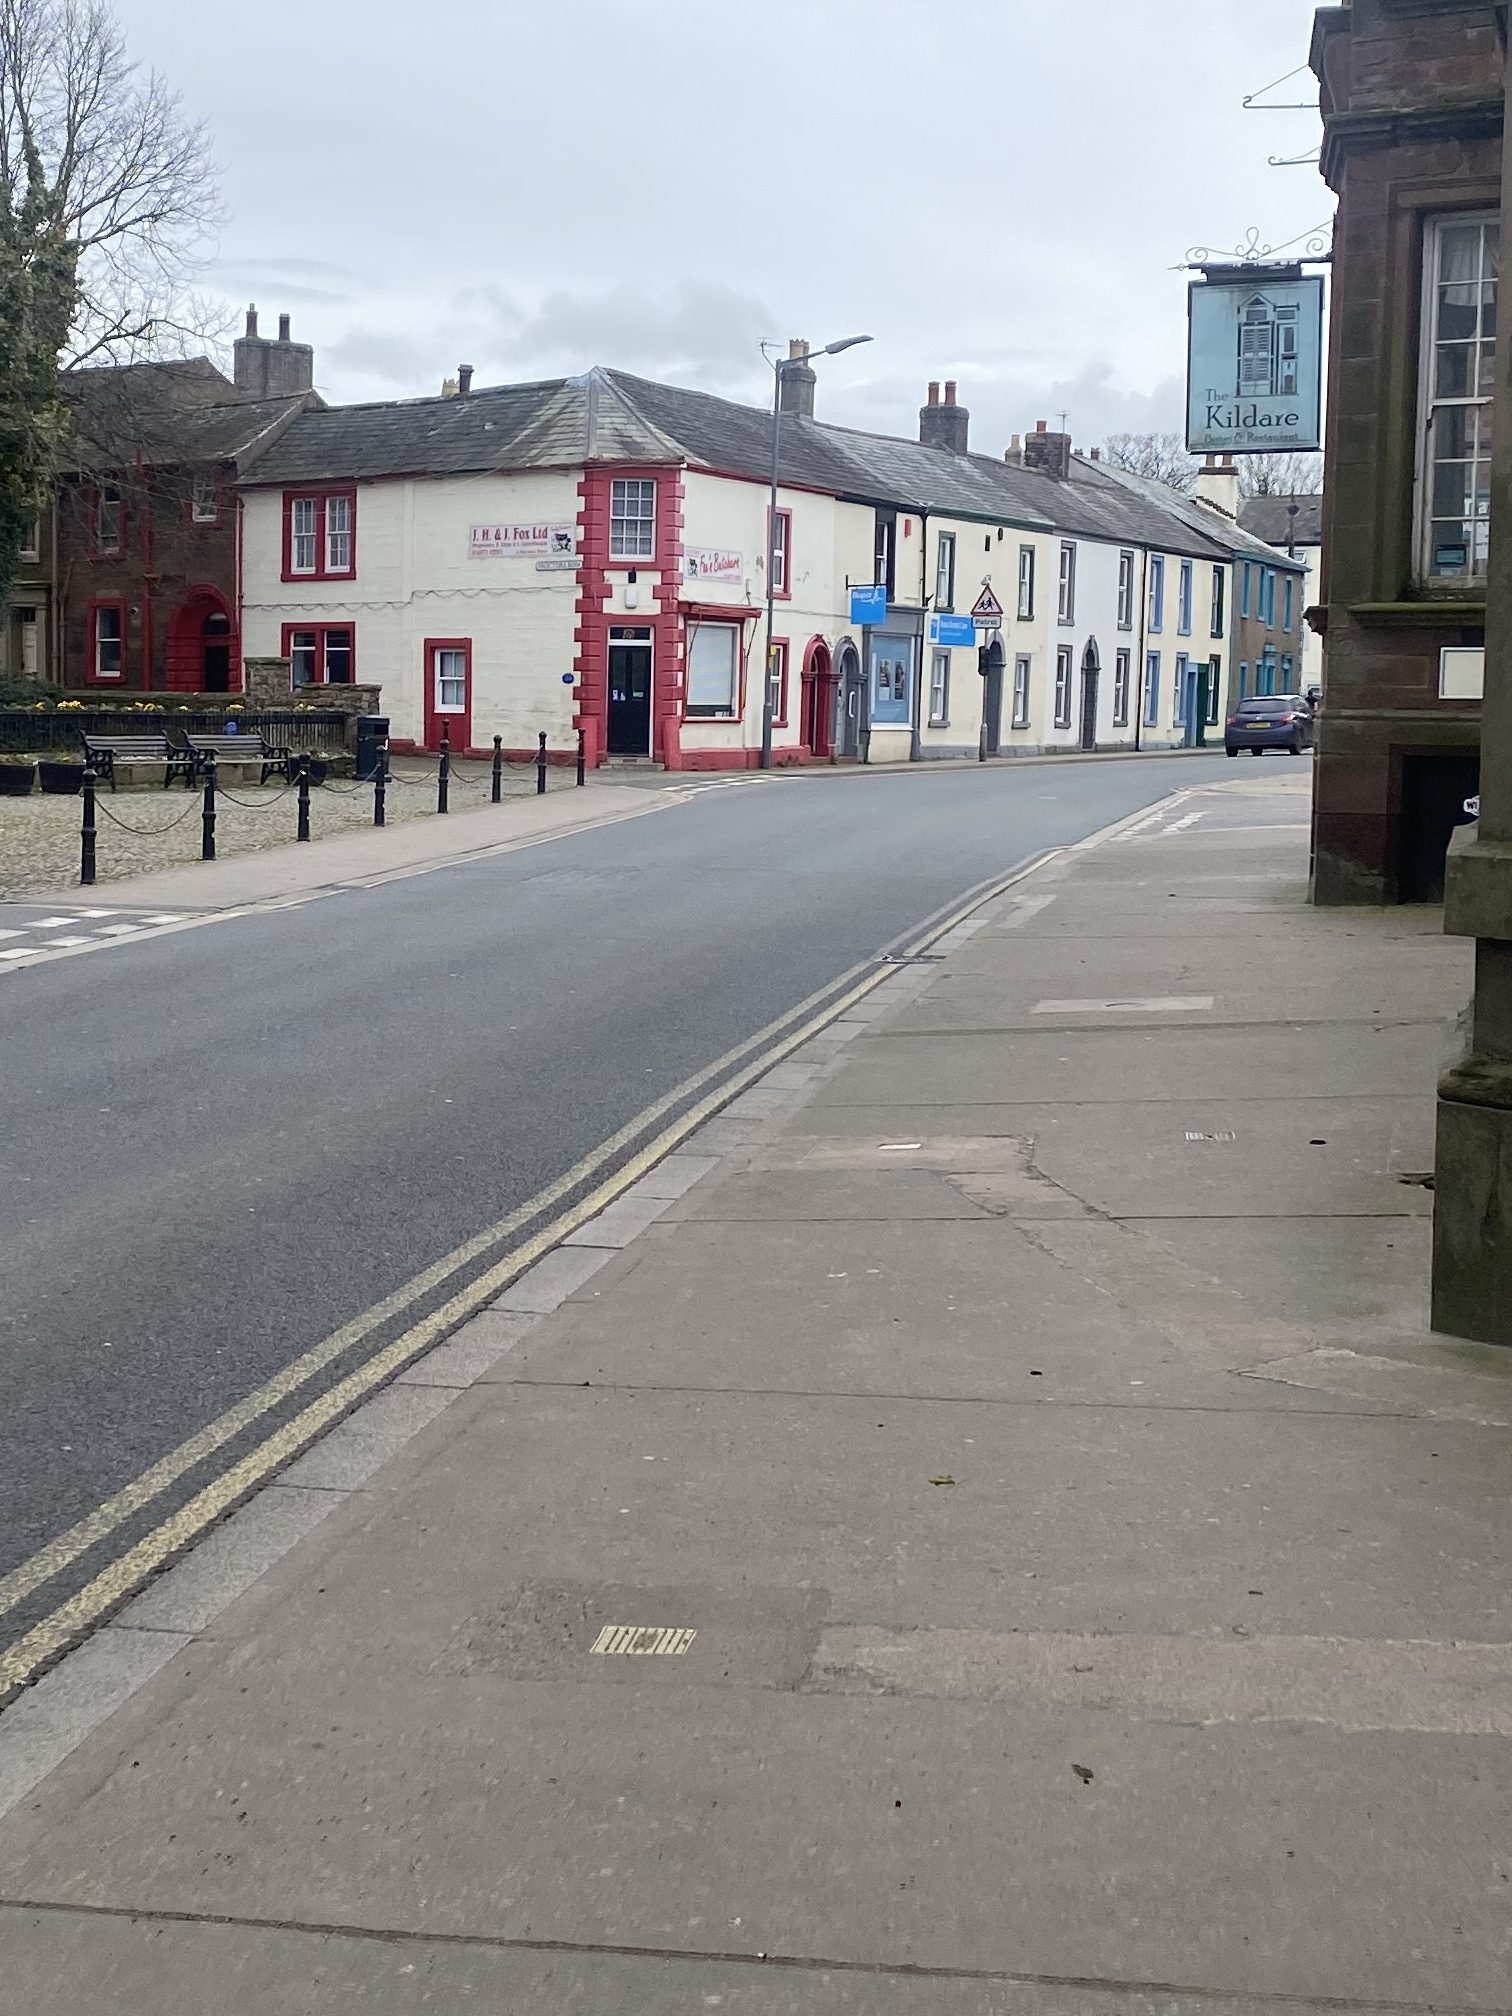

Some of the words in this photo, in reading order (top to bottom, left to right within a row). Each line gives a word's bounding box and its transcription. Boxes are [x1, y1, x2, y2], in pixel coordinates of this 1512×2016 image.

[1206, 388, 1229, 402] The
[1204, 404, 1299, 429] Kildare
[1247, 431, 1298, 442] Restaurant
[494, 528, 502, 540] &
[513, 527, 530, 540] Fox
[533, 526, 548, 539] Ltd
